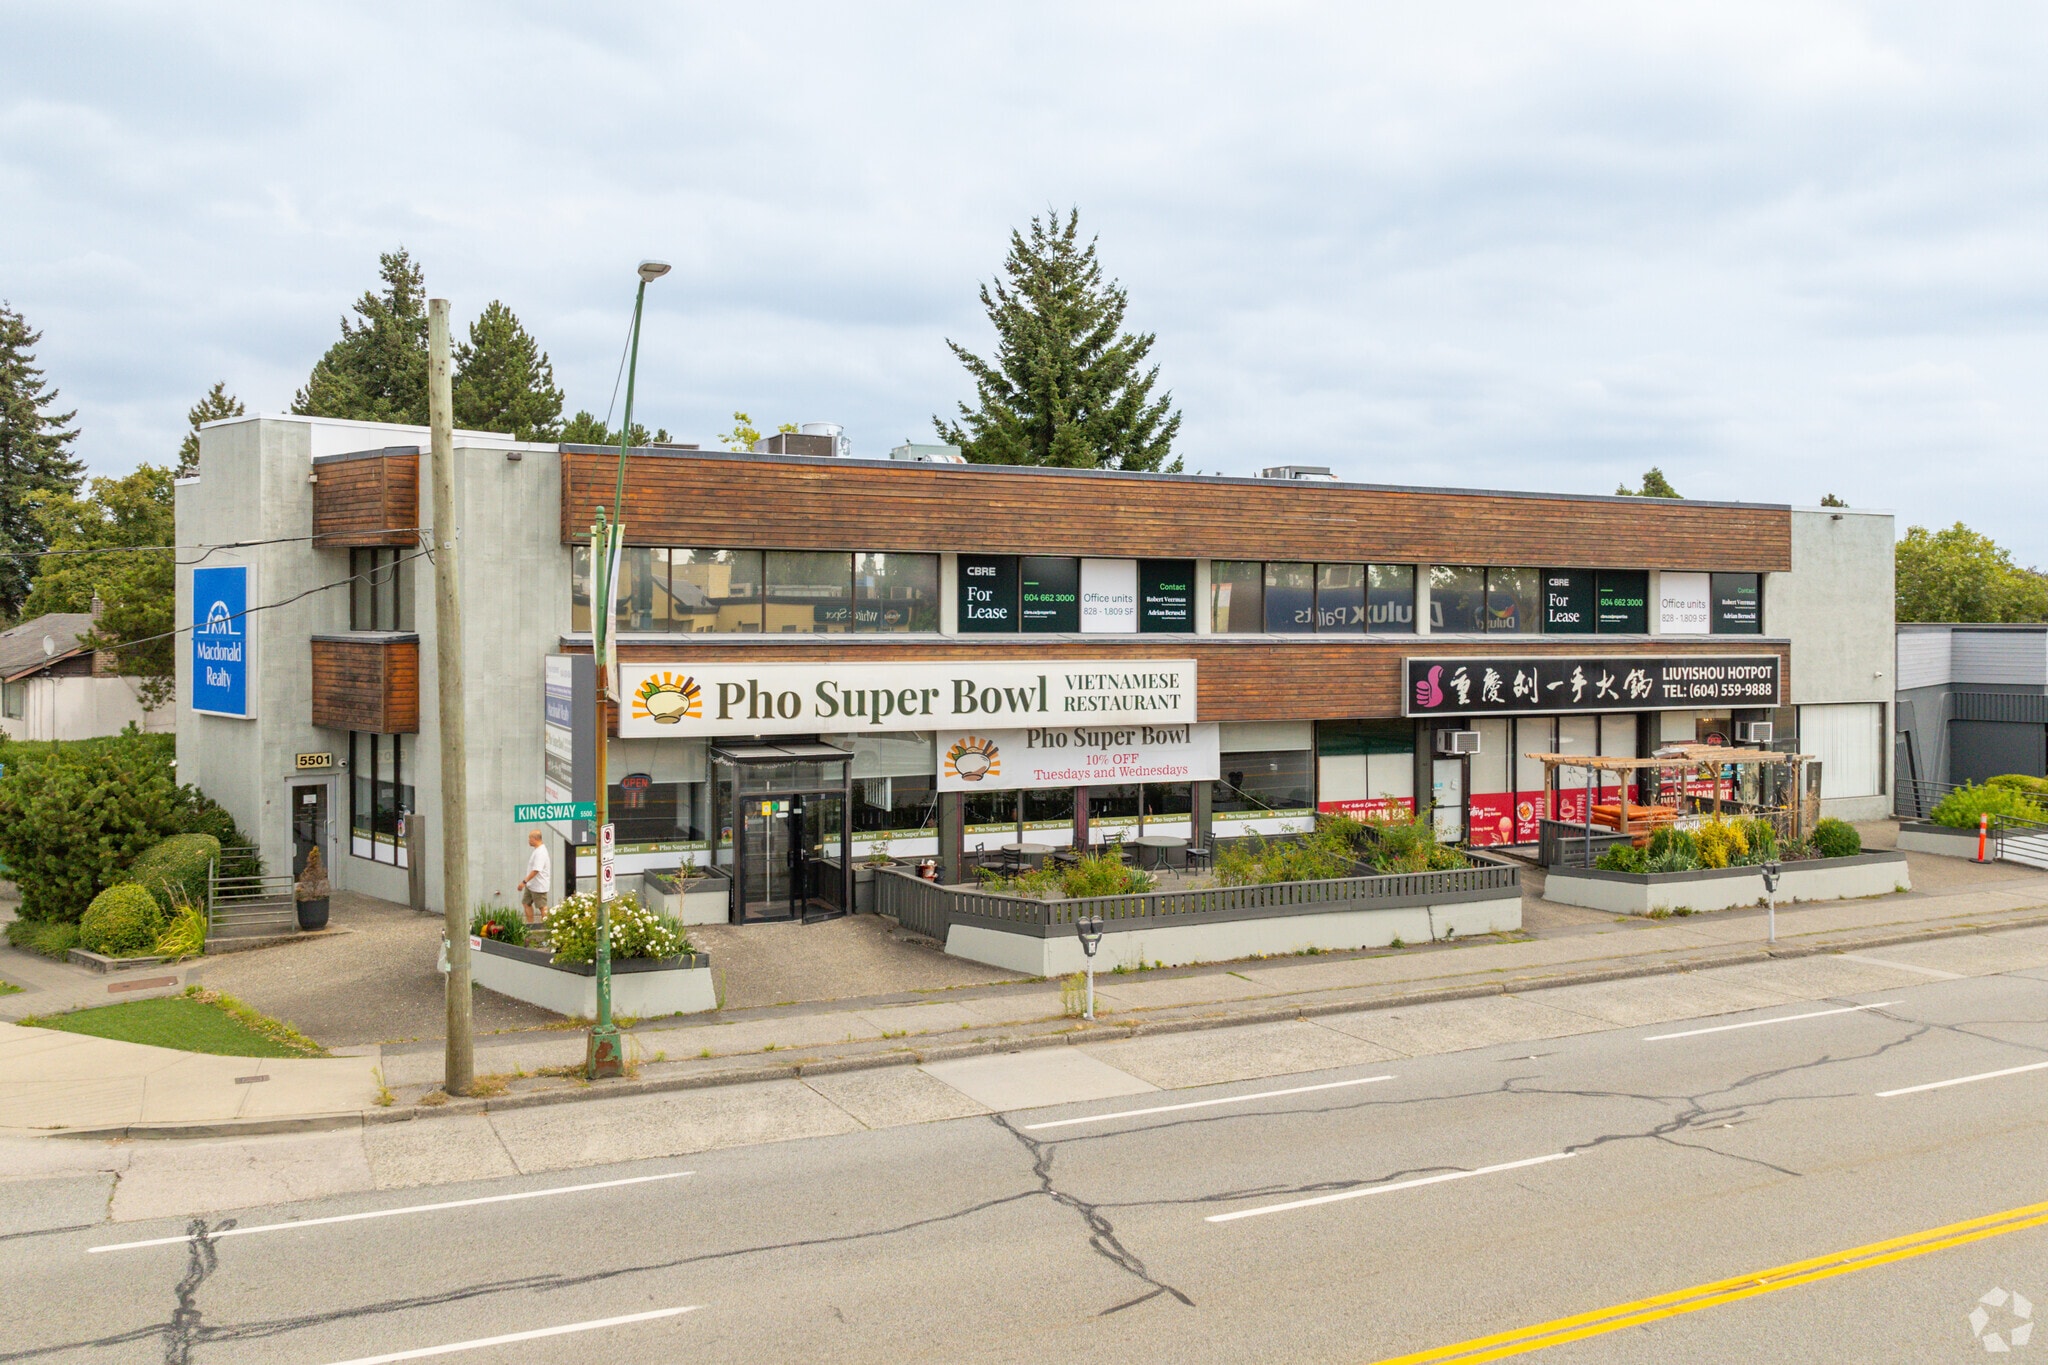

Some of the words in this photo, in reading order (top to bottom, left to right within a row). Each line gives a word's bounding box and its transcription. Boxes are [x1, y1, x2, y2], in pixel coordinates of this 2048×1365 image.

[967, 566, 996, 576] CBRE
[1159, 583, 1186, 591] Contact
[1548, 578, 1570, 586] CBRE
[967, 586, 993, 601] For
[1040, 594, 1055, 602] 662
[1055, 594, 1075, 602] 3000
[1083, 593, 1110, 603] Office
[1112, 595, 1133, 603] units
[1549, 593, 1568, 606] For
[1627, 598, 1643, 607] 3000
[1661, 598, 1685, 609] Office
[1687, 599, 1706, 609] units
[967, 604, 1008, 619] Lease
[1083, 607, 1098, 615] 828
[1124, 608, 1134, 616] SF
[1549, 609, 1580, 622] Lease
[1661, 614, 1675, 623] 828
[1699, 614, 1707, 622] SF
[197, 641, 241, 662] Macdonald
[206, 666, 232, 692] Realty
[1662, 666, 1725, 680] LIUYISHOU
[1727, 666, 1773, 679] HOTPOT
[1064, 673, 1180, 690] VIETNAMESE
[1662, 684, 1687, 698] TEL:
[1689, 683, 1719, 699] (604)
[1720, 683, 1772, 697] 559-9888
[716, 679, 801, 720] Pho
[815, 680, 939, 725] Super
[951, 675, 1049, 714] Bowl
[1064, 694, 1181, 712] RESTAURANT
[1026, 727, 1068, 749] Pho
[1074, 726, 1136, 751] Super
[1141, 723, 1192, 746] Bowl
[300, 755, 331, 766] 5501
[1086, 754, 1109, 766] 10%
[1112, 753, 1139, 764] OFF
[1034, 768, 1091, 782] Tuesdays
[1094, 766, 1116, 778] and
[1119, 765, 1189, 777] Wednesdays
[623, 778, 649, 788] OPEN
[518, 805, 576, 820] KINGSWAY
